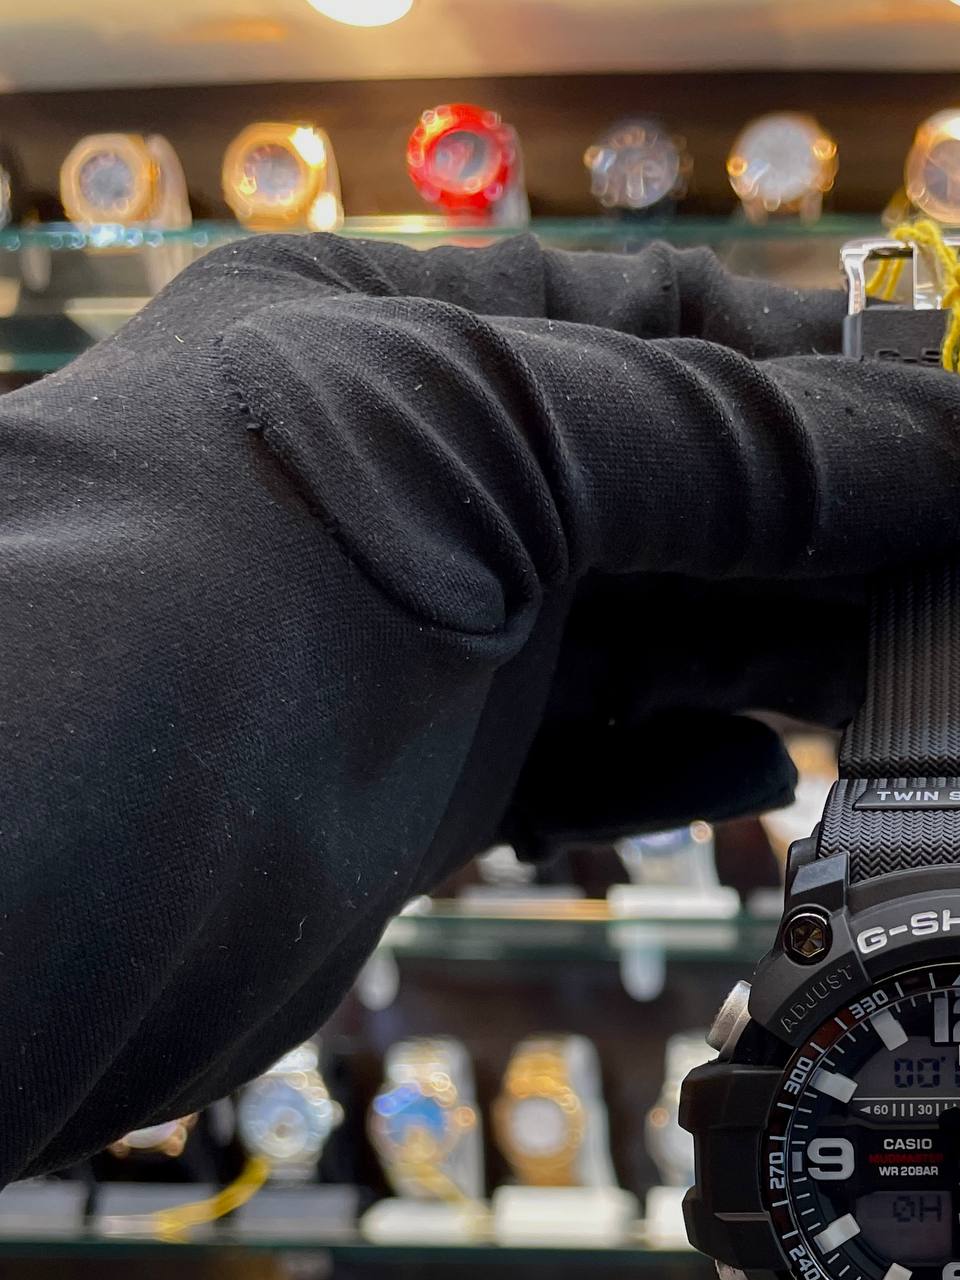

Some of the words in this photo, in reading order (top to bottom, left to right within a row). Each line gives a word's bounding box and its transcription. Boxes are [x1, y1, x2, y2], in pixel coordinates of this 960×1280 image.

[876, 790, 938, 801] TWIN
[780, 964, 853, 1033] ADJUST
[848, 988, 889, 1019] 330
[783, 1056, 814, 1095] 300
[873, 1104, 889, 1115] 60
[917, 1104, 931, 1115] 30
[806, 1137, 855, 1181] 9
[883, 1138, 933, 1150] CASIO
[769, 1151, 785, 1190] 270
[878, 1166, 899, 1176] WR
[900, 1166, 939, 1176] 20BAR
